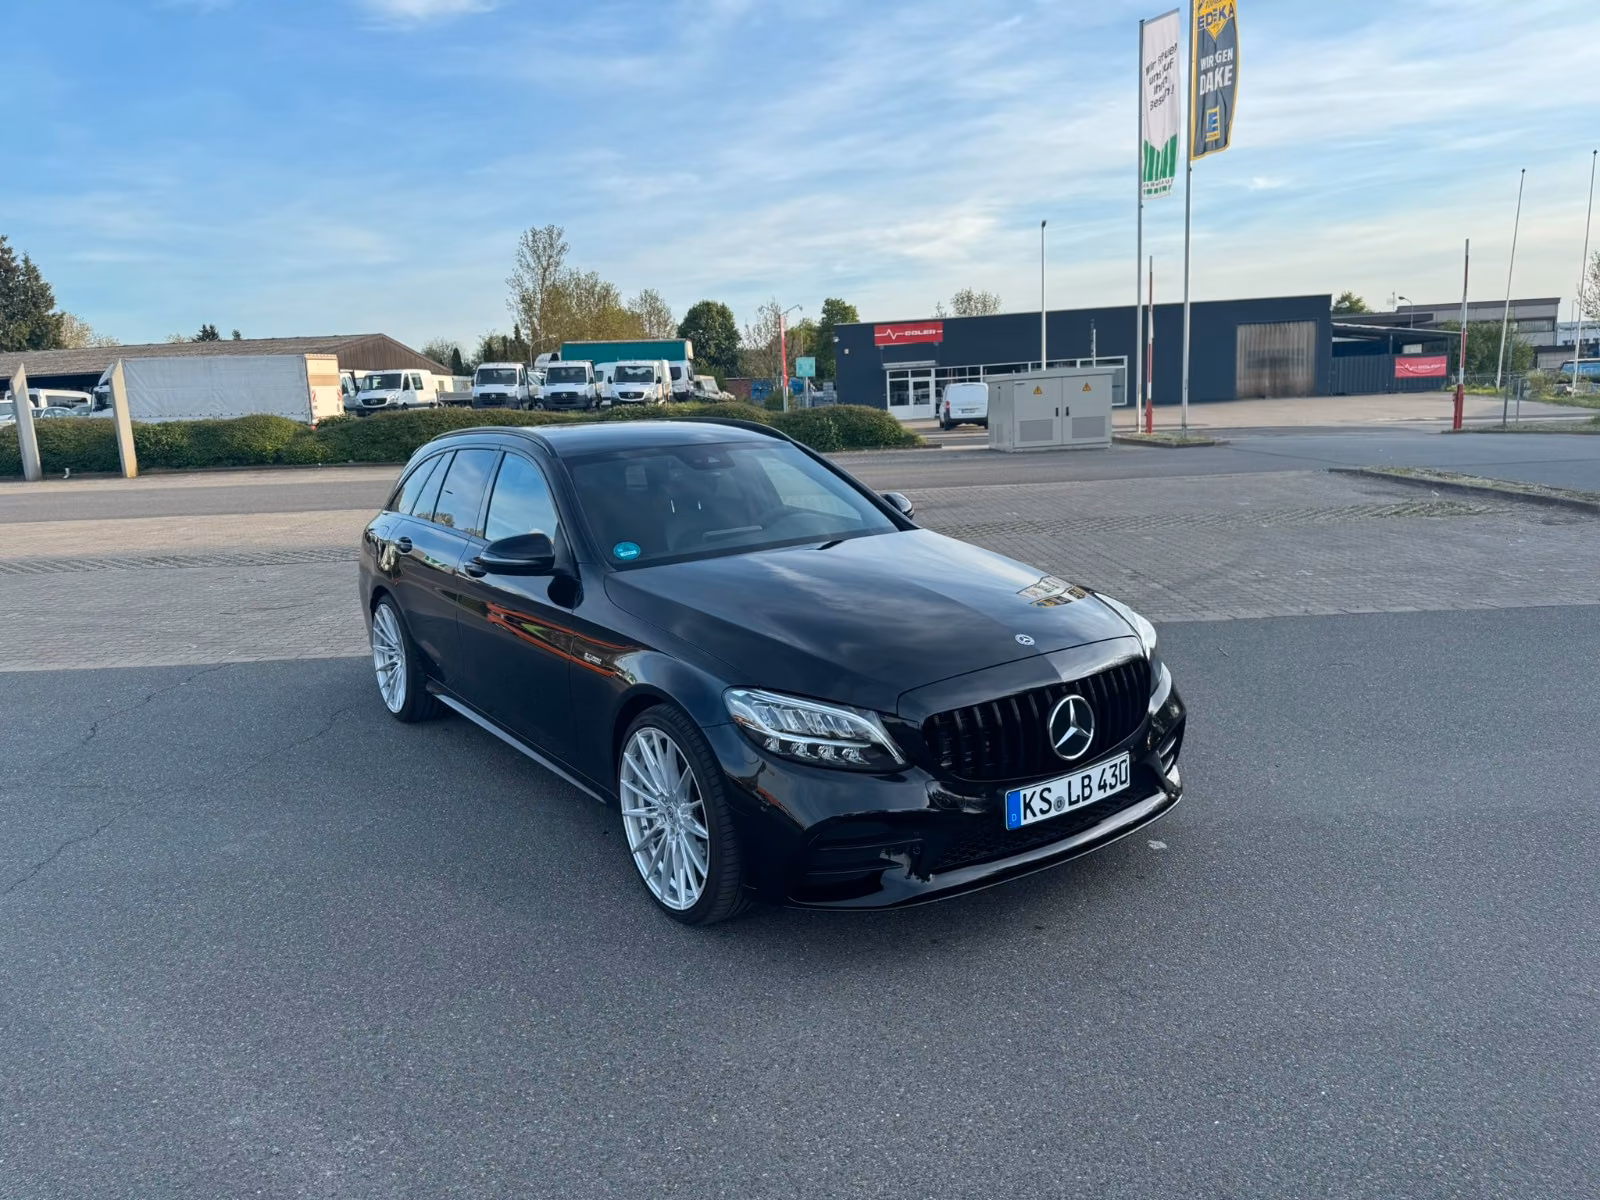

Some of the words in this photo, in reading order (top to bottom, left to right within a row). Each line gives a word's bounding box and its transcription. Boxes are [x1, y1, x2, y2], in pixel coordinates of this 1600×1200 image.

[1023, 786, 1052, 821] KS
[1067, 773, 1093, 806] LB
[1098, 758, 1128, 793] 430
[1011, 813, 1017, 822] D
